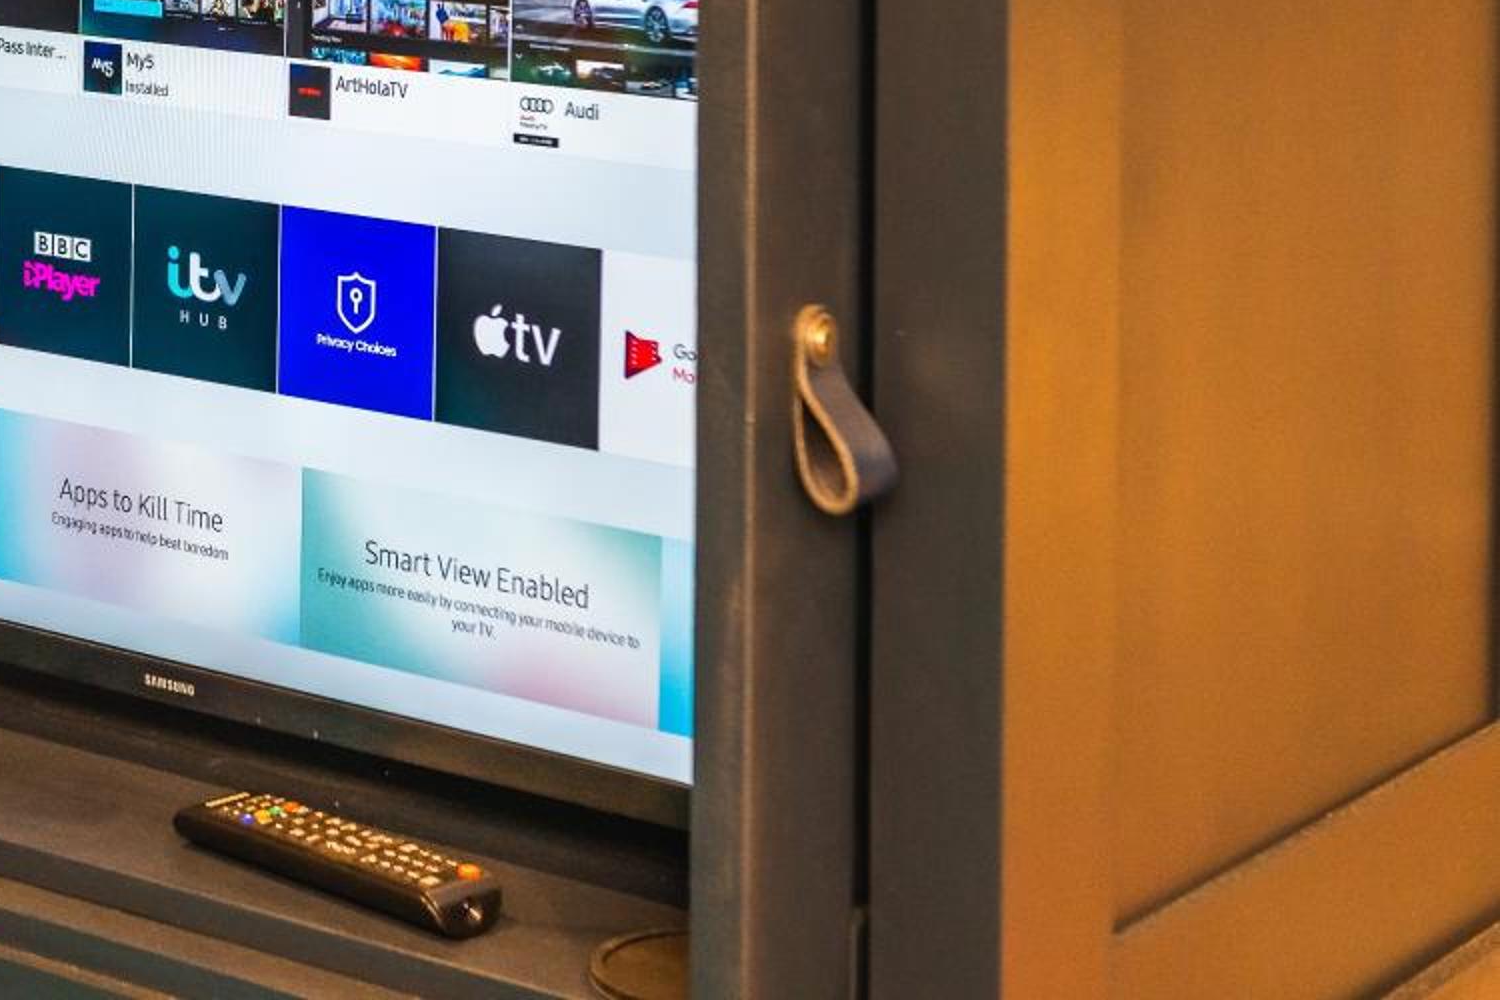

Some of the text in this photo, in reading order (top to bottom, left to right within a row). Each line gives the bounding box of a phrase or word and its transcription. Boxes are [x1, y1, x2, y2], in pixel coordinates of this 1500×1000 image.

[126, 52, 155, 72] My5
[125, 80, 169, 97] Installed
[335, 76, 408, 99] ArtHolaTV
[565, 101, 599, 120] Audi
[35, 232, 91, 262] BBC
[22, 259, 100, 302] iPlayer
[167, 245, 247, 306] itv
[179, 309, 228, 330] HUB
[316, 333, 397, 357] Privacy Choices
[510, 312, 562, 366] tv
[59, 478, 223, 533] Apps to Kill Time
[51, 511, 229, 560] Engaging apps to help beat boredom
[365, 539, 589, 609] Smart View Enabled
[318, 567, 641, 649] Enjoy apps more easily by connecting your mobile device to
[451, 618, 477, 633] your
[144, 673, 195, 697] SAMSUNG
